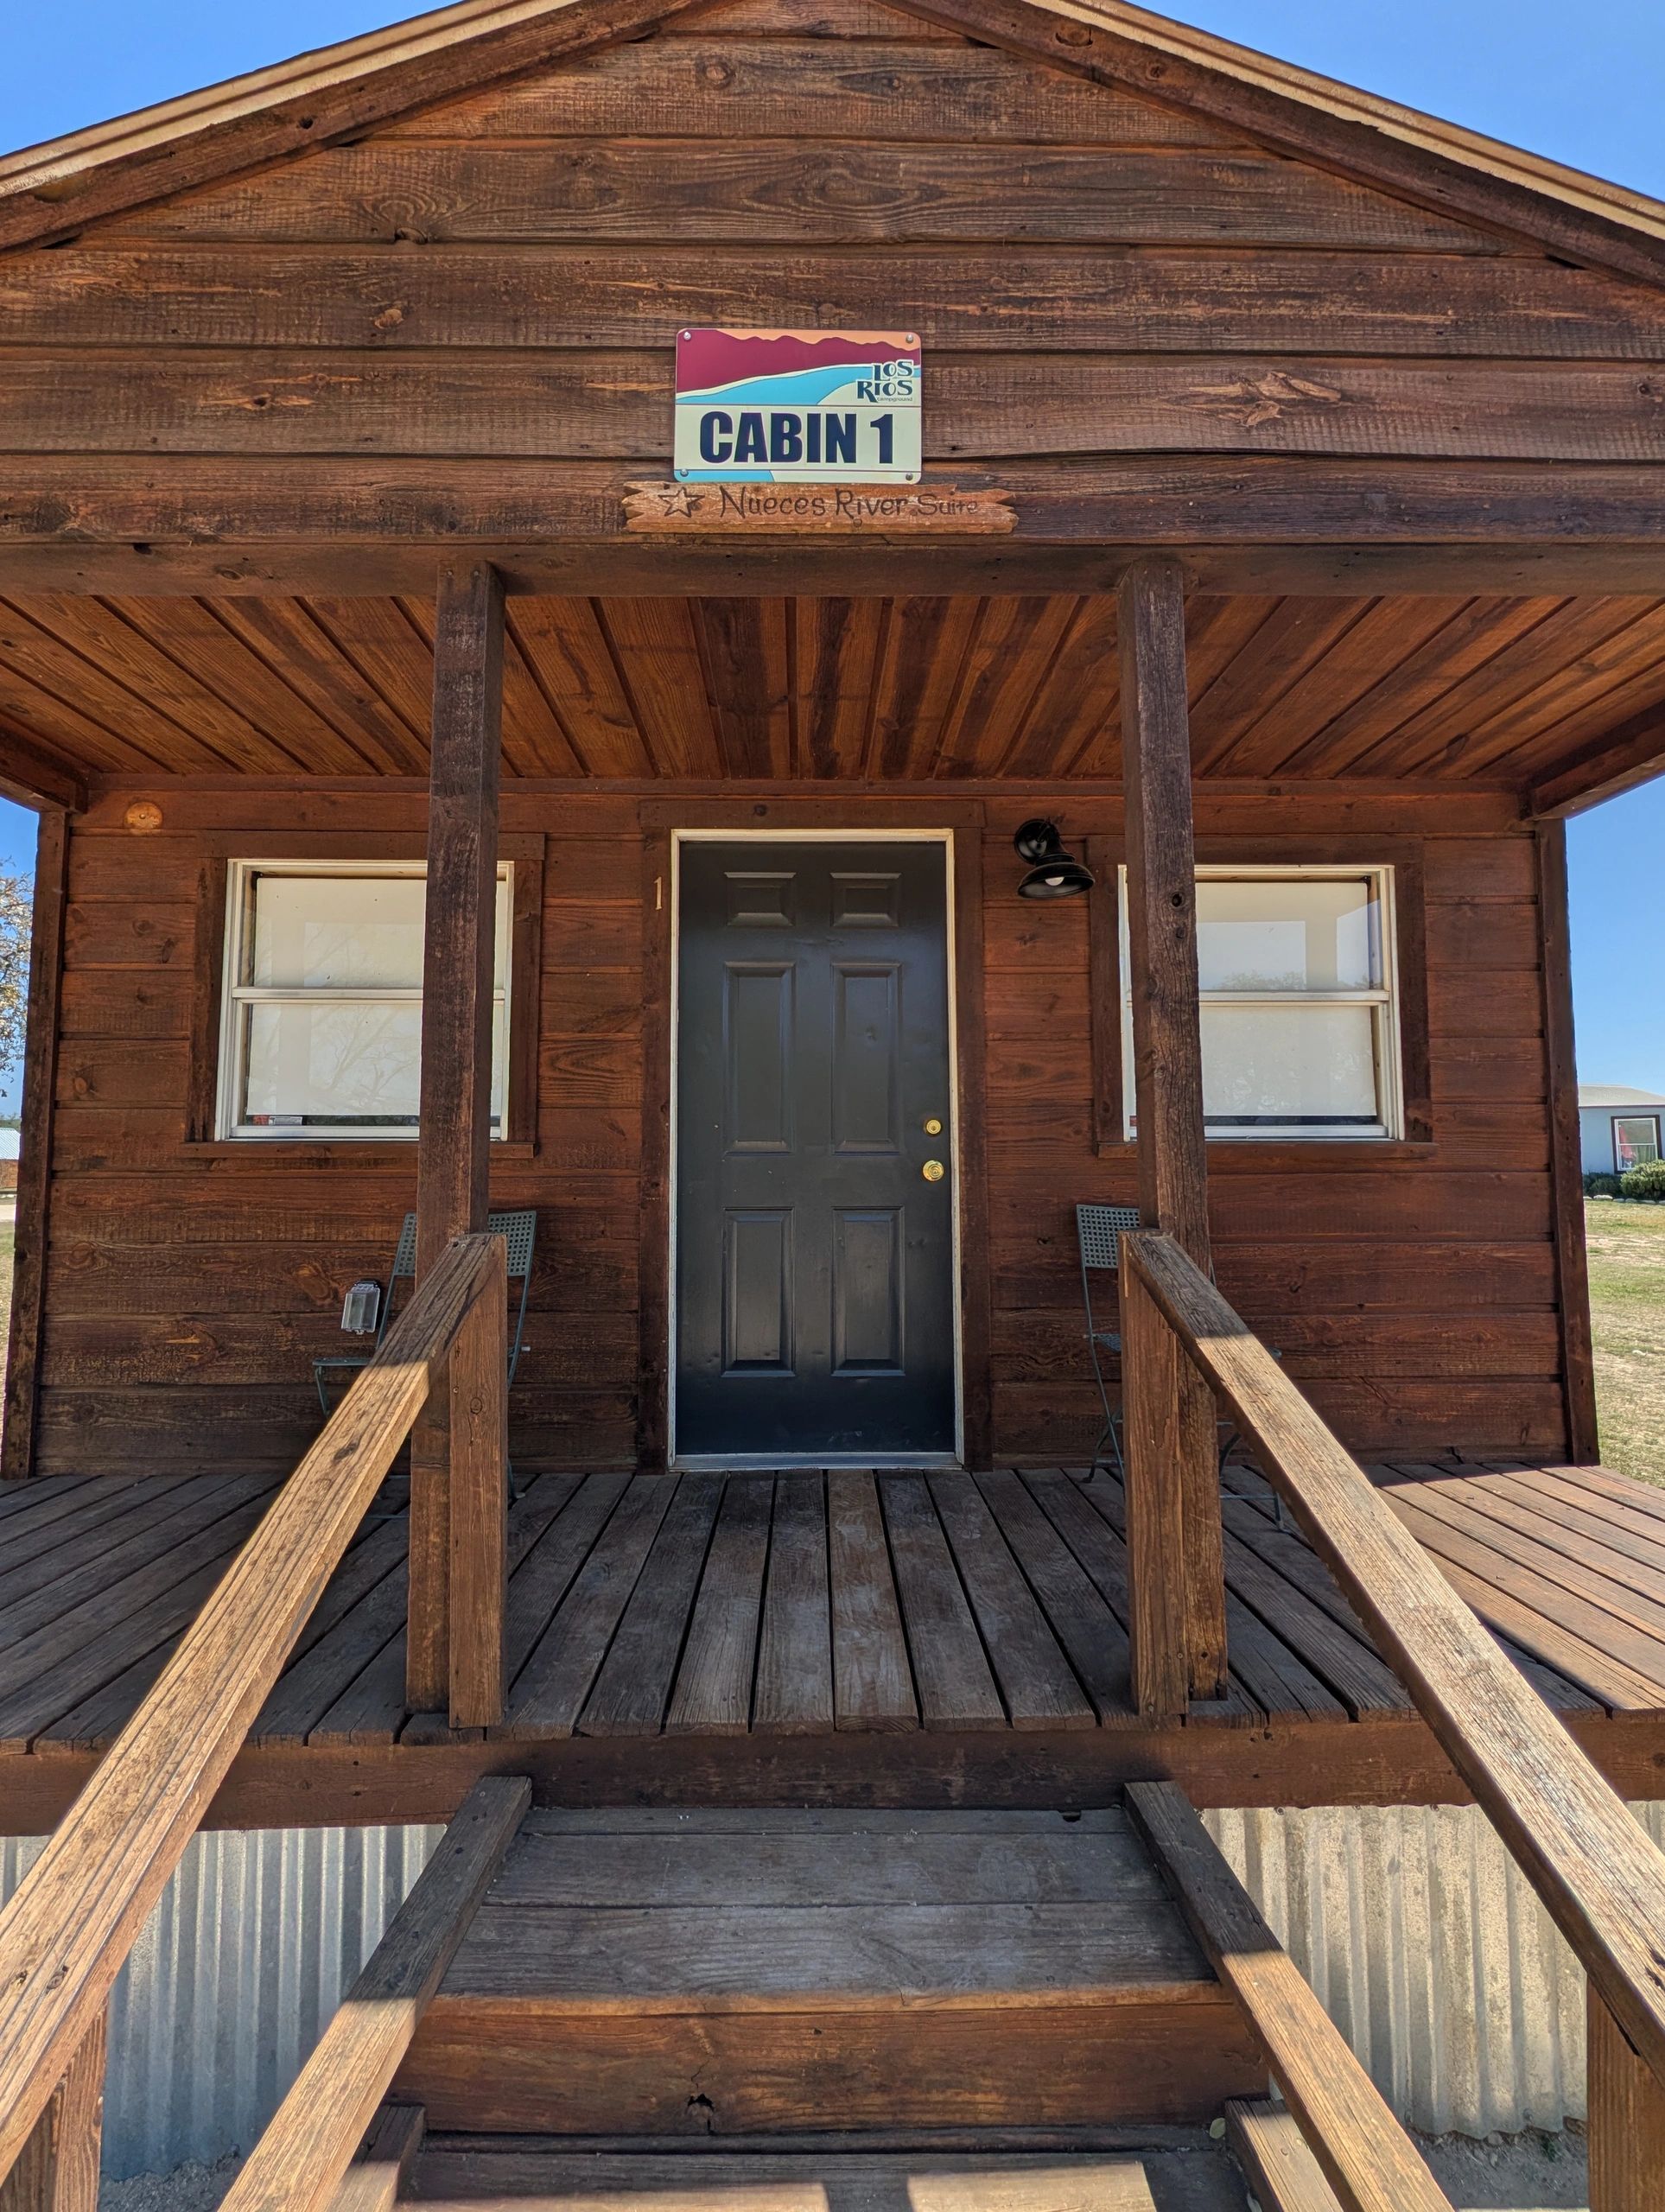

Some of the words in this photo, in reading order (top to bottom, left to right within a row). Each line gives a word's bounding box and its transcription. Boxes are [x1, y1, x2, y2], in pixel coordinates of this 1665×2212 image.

[874, 360, 912, 381] LOS
[699, 410, 857, 464] CABIN
[870, 413, 893, 464] 1
[720, 485, 826, 518] Nueces
[835, 488, 908, 519] River
[917, 492, 978, 516] Suite
[653, 876, 663, 910] 1
